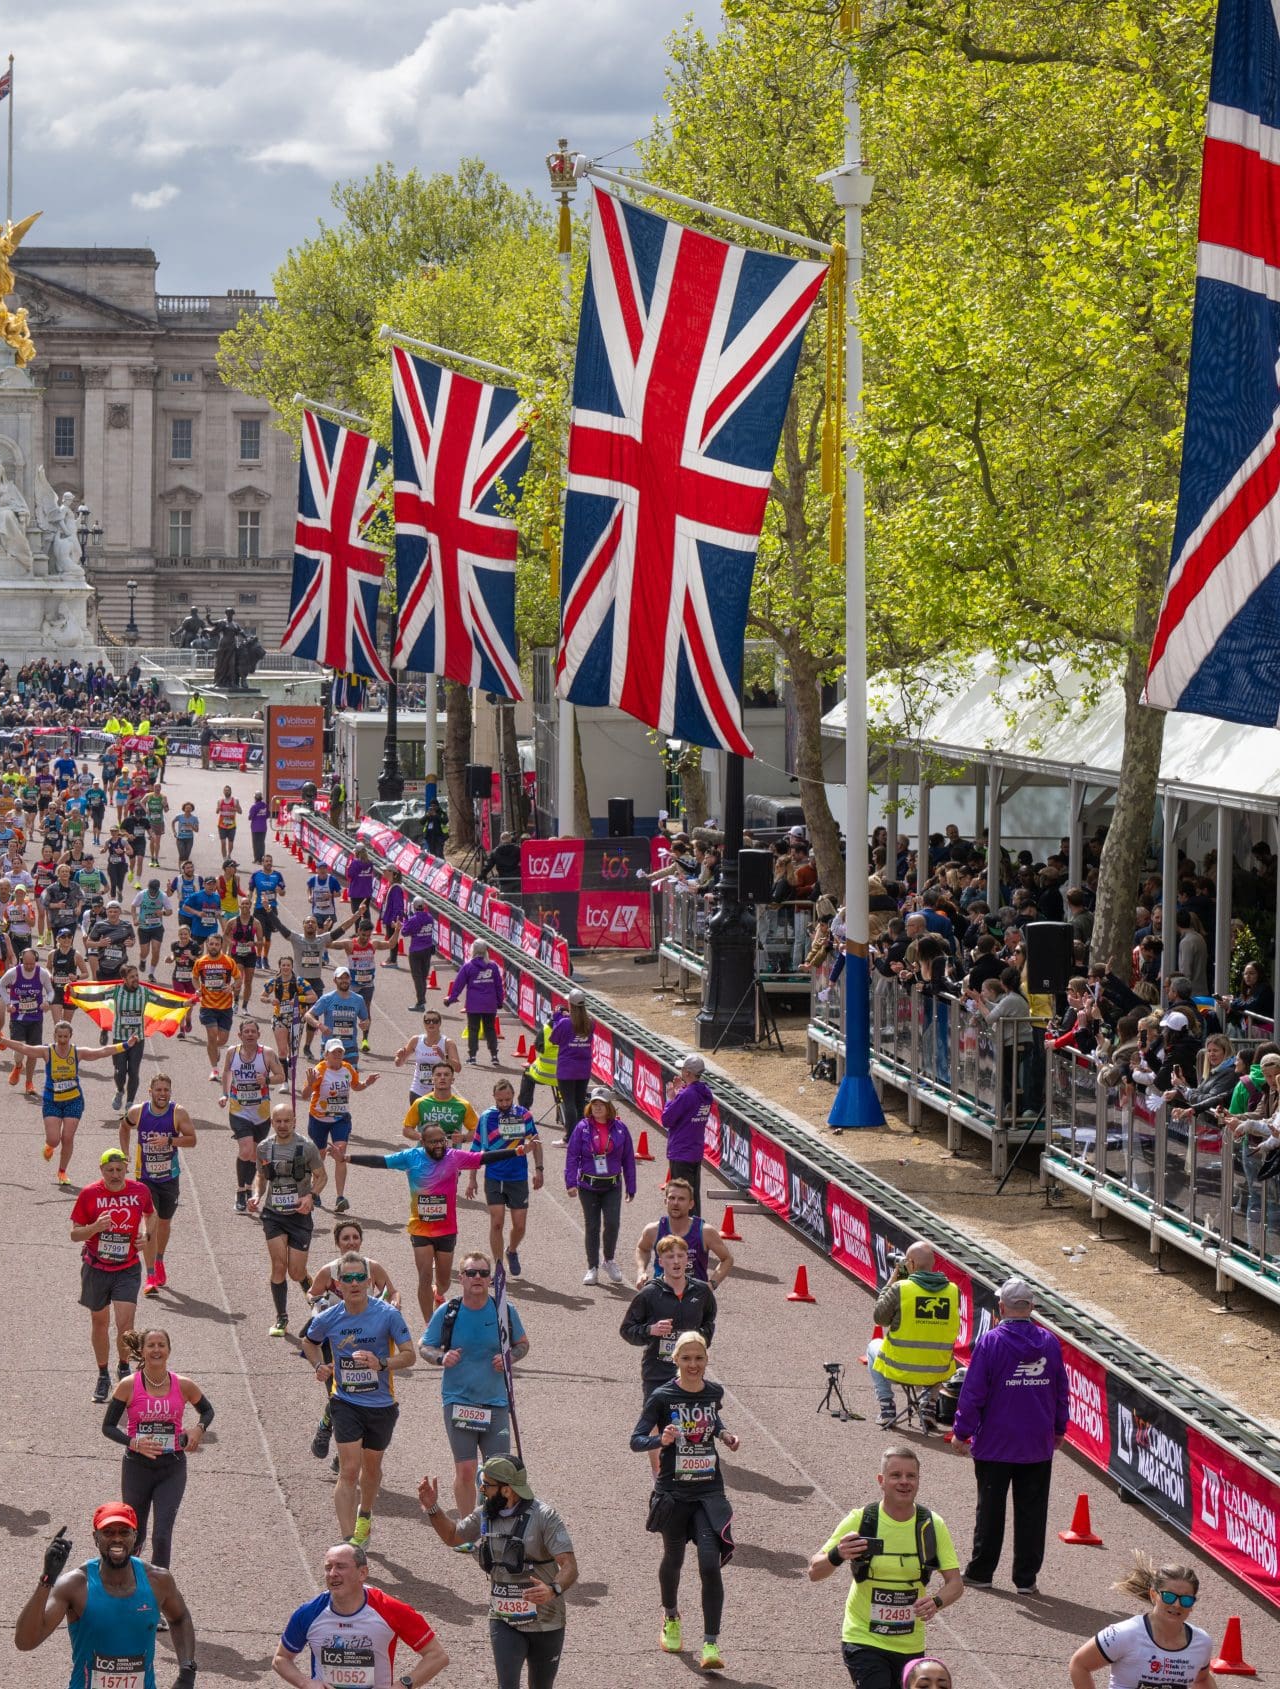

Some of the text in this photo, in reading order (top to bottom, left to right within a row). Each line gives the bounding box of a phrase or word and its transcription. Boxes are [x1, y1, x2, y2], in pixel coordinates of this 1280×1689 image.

[287, 716, 316, 725] Voltarol
[286, 759, 315, 768] Voltarol
[528, 854, 551, 876] tcs
[601, 852, 630, 879] tcs
[585, 905, 609, 928] tcs
[431, 1105, 453, 1114] ALEX
[424, 1112, 459, 1123] NSPCC
[96, 1195, 139, 1208] MARK
[1005, 1378, 1050, 1387] new balance
[1068, 1364, 1101, 1413] LONDON
[147, 1399, 170, 1414] LOU
[458, 1408, 486, 1421] 20529
[1067, 1395, 1104, 1444] RATHON
[1149, 1427, 1183, 1475] LONDON
[1138, 1446, 1185, 1508] MARATHON
[1235, 1486, 1276, 1544] LONDON
[1225, 1510, 1278, 1578] MARATHON
[874, 1590, 893, 1603] tcs
[497, 1600, 529, 1613] 24382
[878, 1607, 911, 1621] 12493
[96, 1656, 115, 1671] tcs
[324, 1650, 343, 1664] tcs
[1165, 1657, 1190, 1665] Cardiac
[330, 1670, 366, 1684] 10552
[1165, 1669, 1186, 1677] Young
[100, 1676, 138, 1689] 15717
